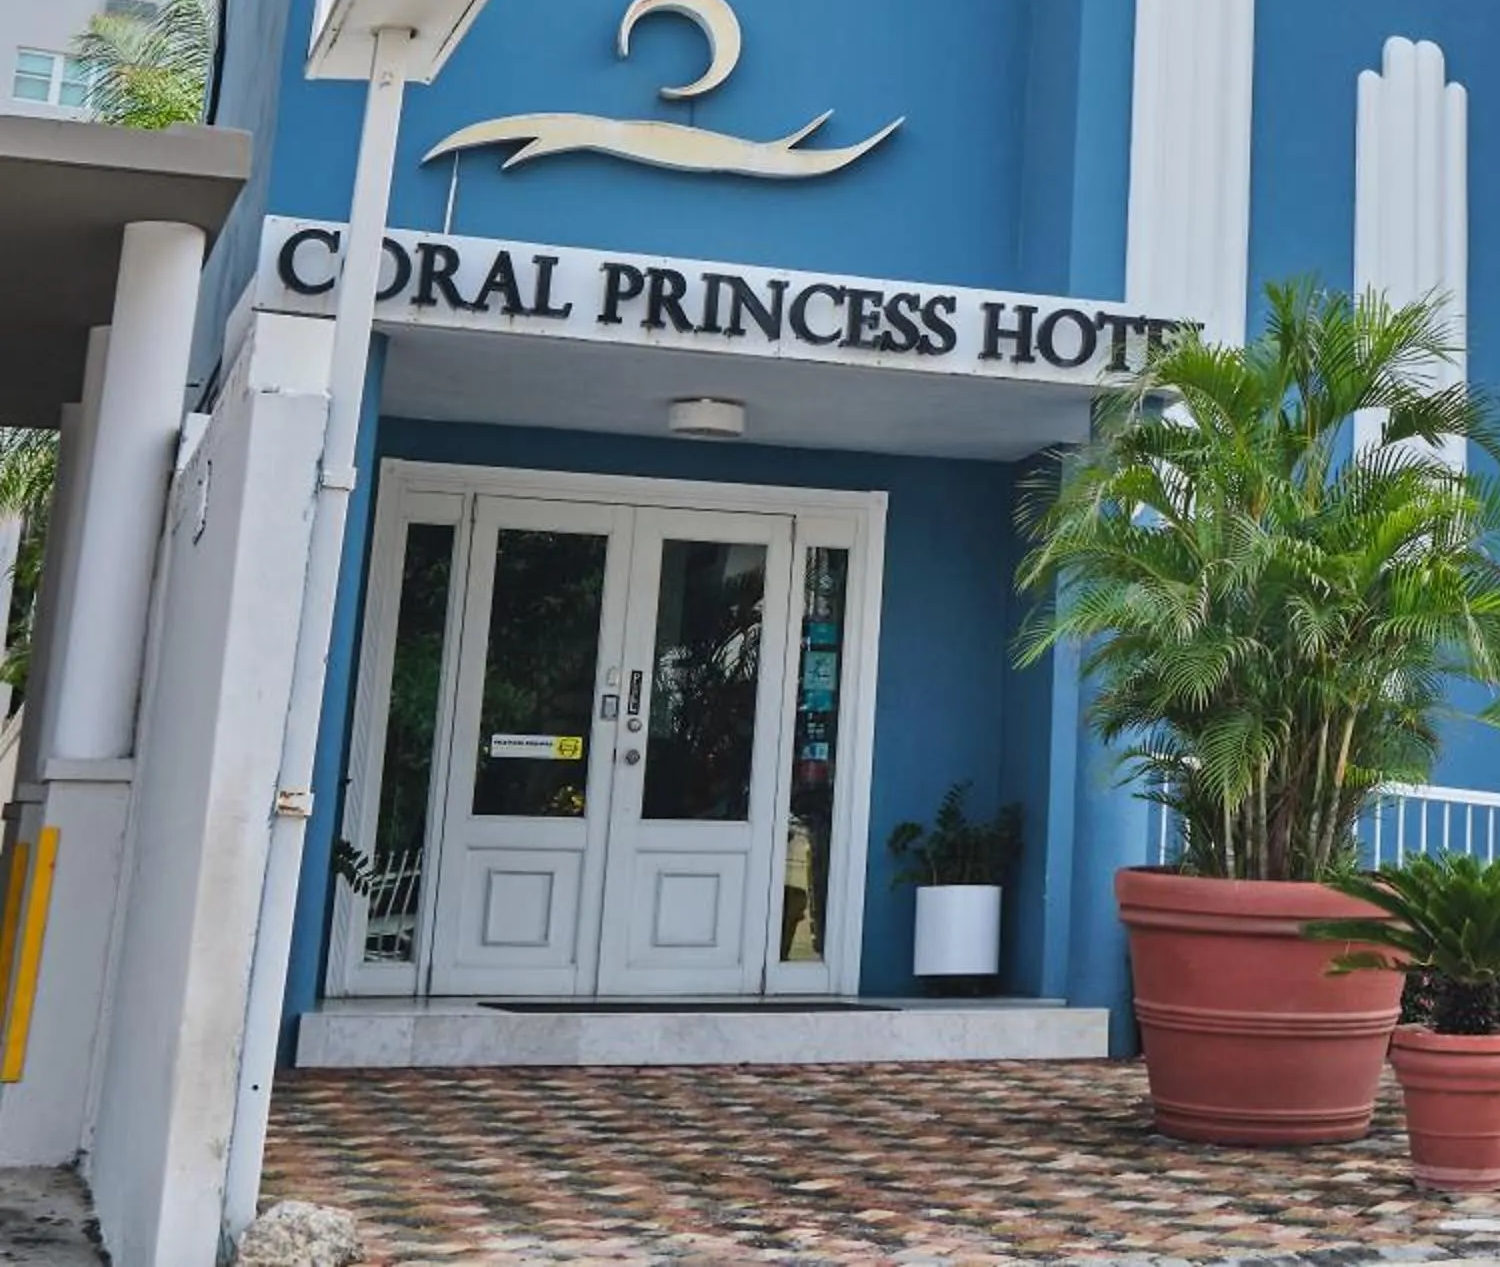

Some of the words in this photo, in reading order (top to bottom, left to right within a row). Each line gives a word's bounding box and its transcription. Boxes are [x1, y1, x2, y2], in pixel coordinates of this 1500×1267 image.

[278, 228, 573, 318] CORAL
[597, 261, 957, 356] PRINCESS
[978, 302, 1206, 373] HOTE
